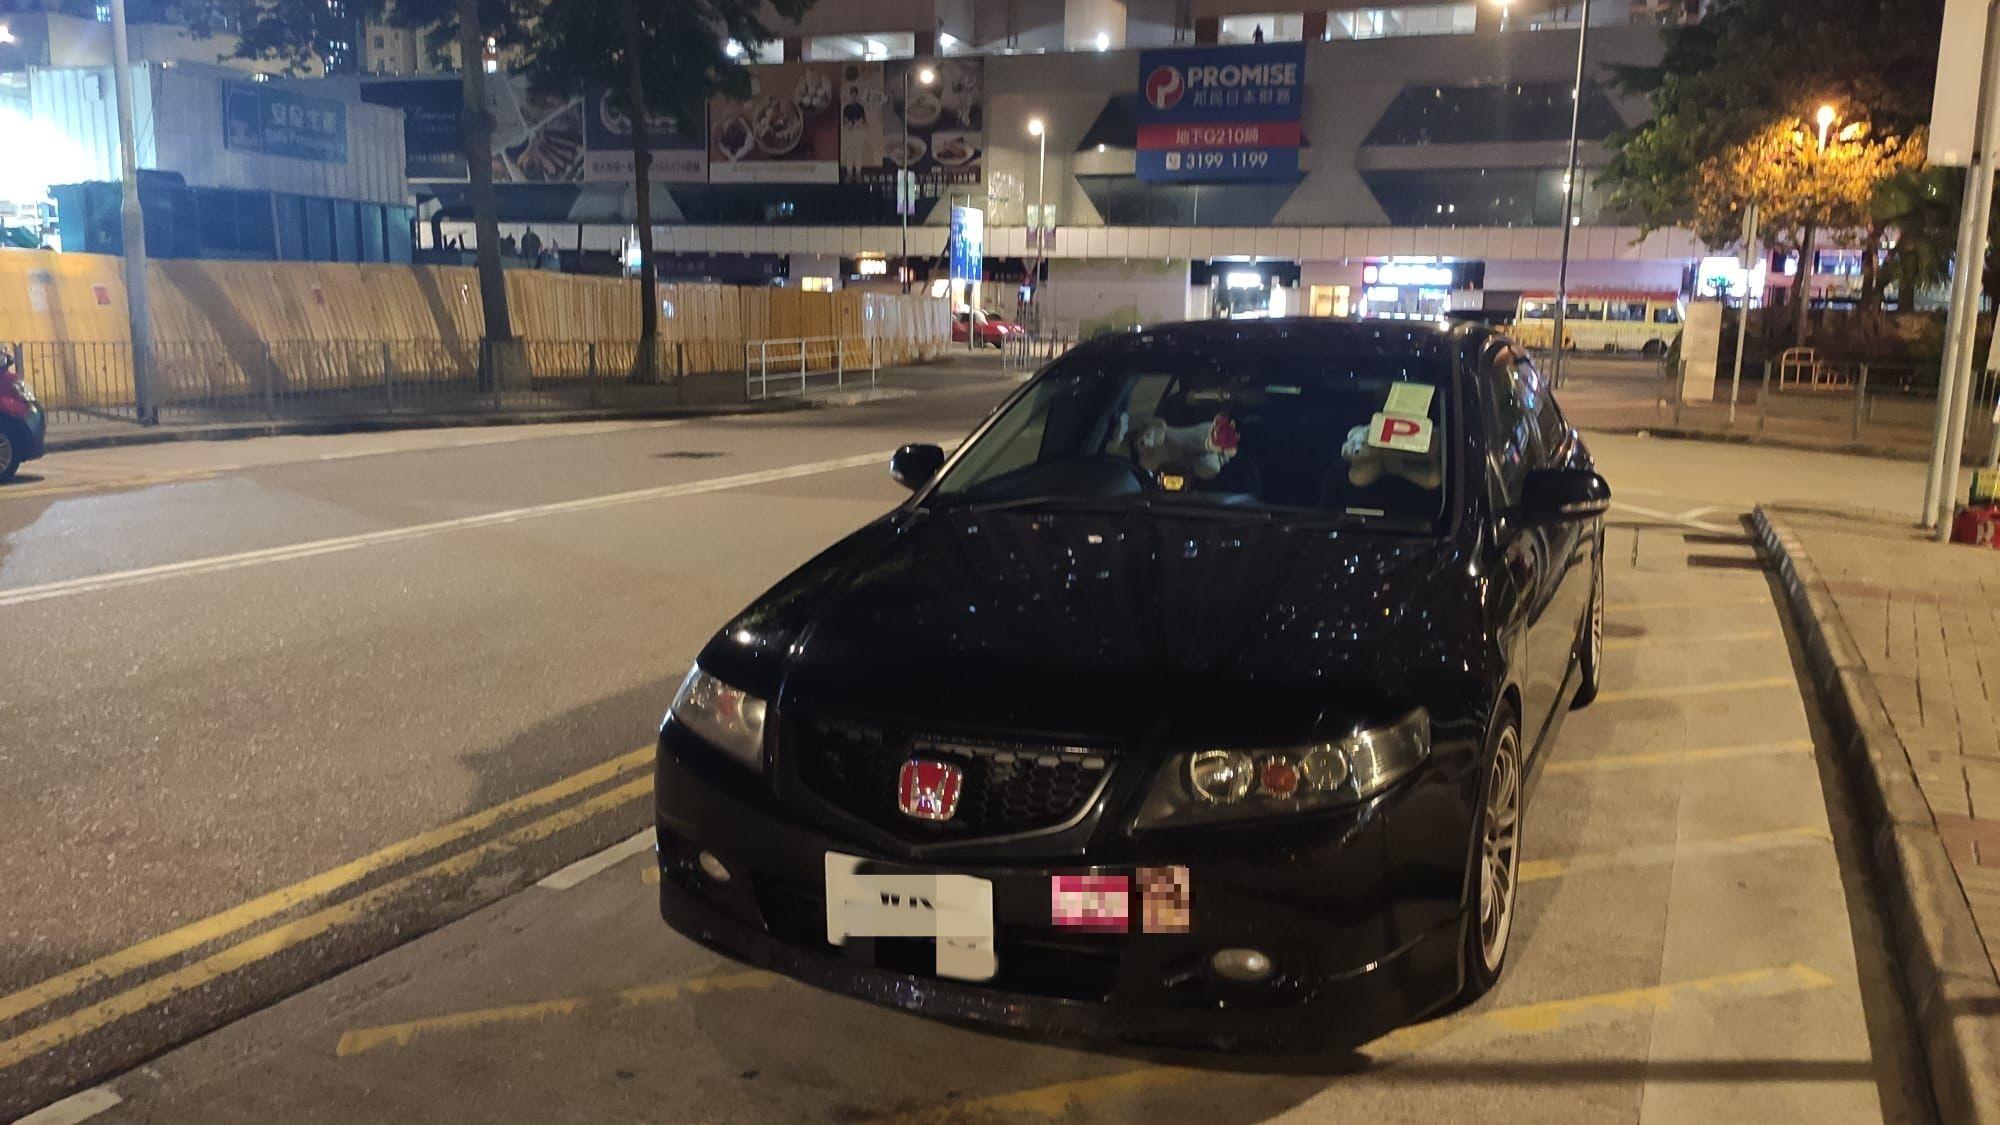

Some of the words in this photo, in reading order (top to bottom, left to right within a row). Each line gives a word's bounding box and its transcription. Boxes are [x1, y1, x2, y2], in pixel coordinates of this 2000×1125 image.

[1187, 63, 1298, 88] PROMISE
[1186, 152, 1223, 170] 3199
[1232, 151, 1268, 169] 1199
[1380, 418, 1421, 443] P
